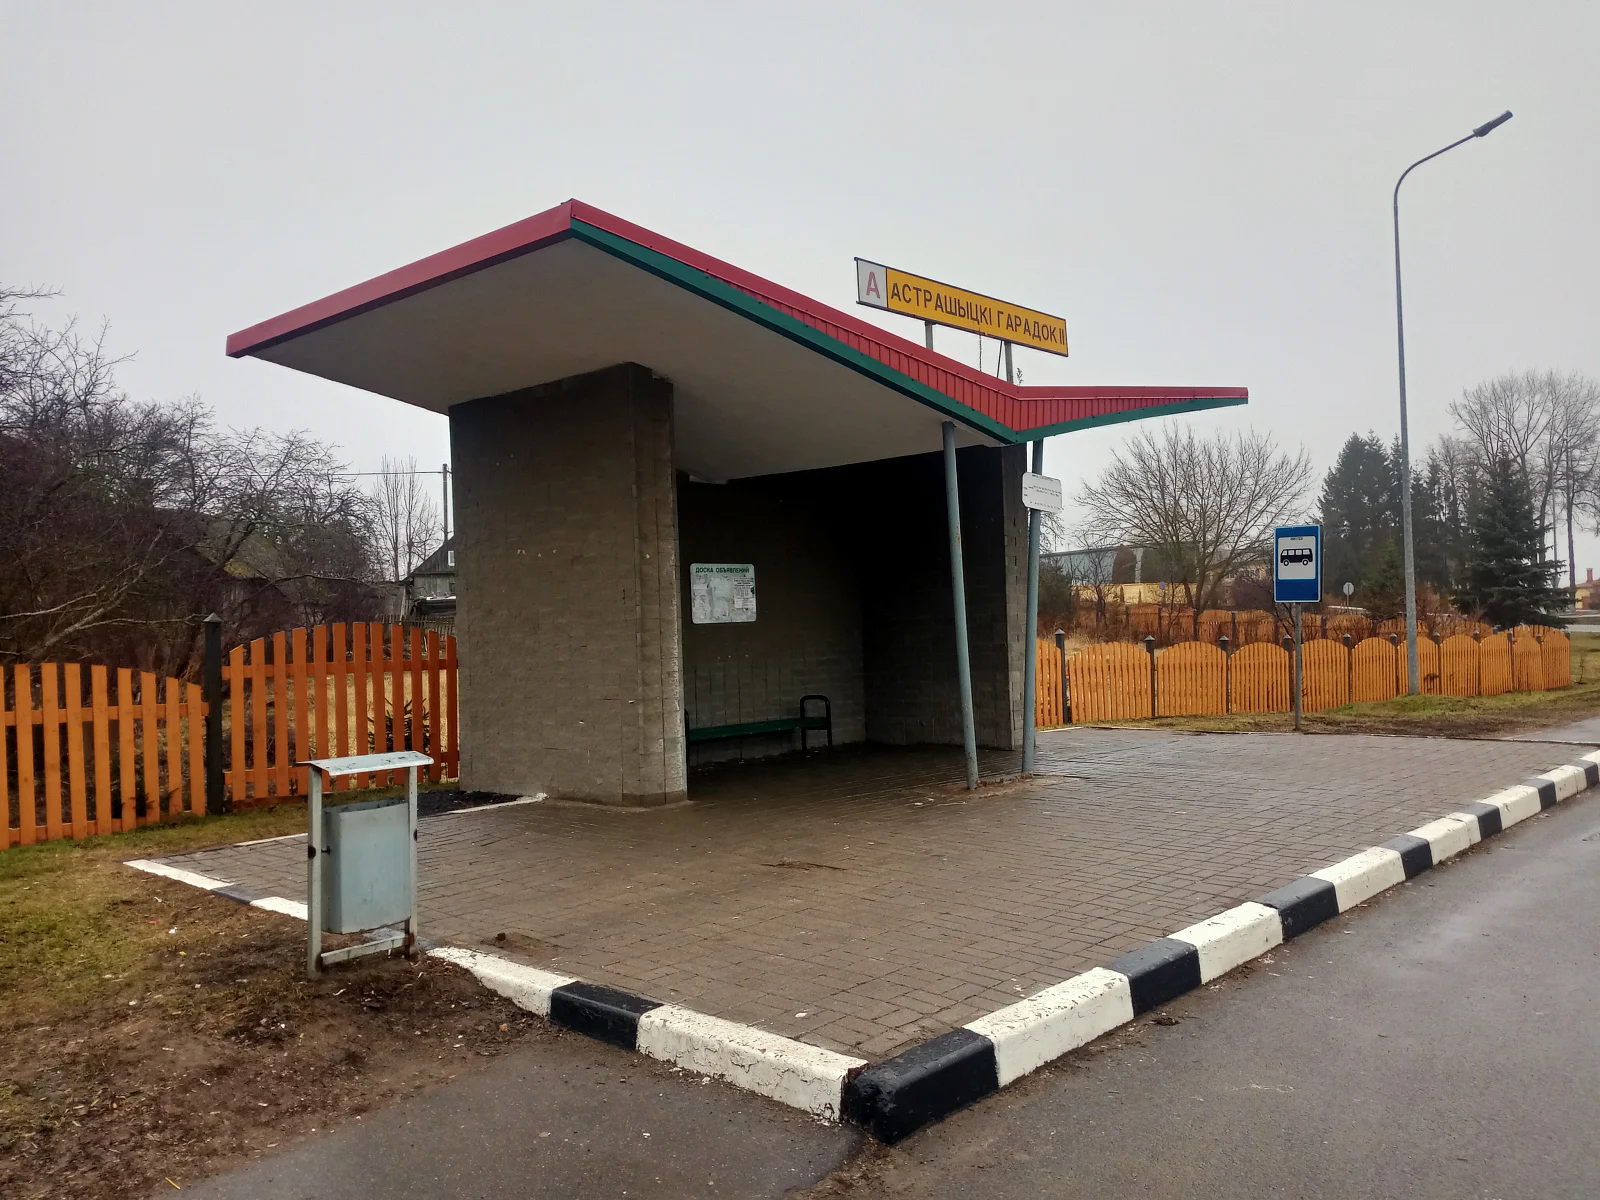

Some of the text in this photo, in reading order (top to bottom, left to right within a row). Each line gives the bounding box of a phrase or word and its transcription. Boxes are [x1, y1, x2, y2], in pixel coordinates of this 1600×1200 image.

[866, 271, 881, 299] А
[891, 282, 992, 326] АСТРАШЫЦКІ
[997, 310, 1058, 344] ГАРАДОК
